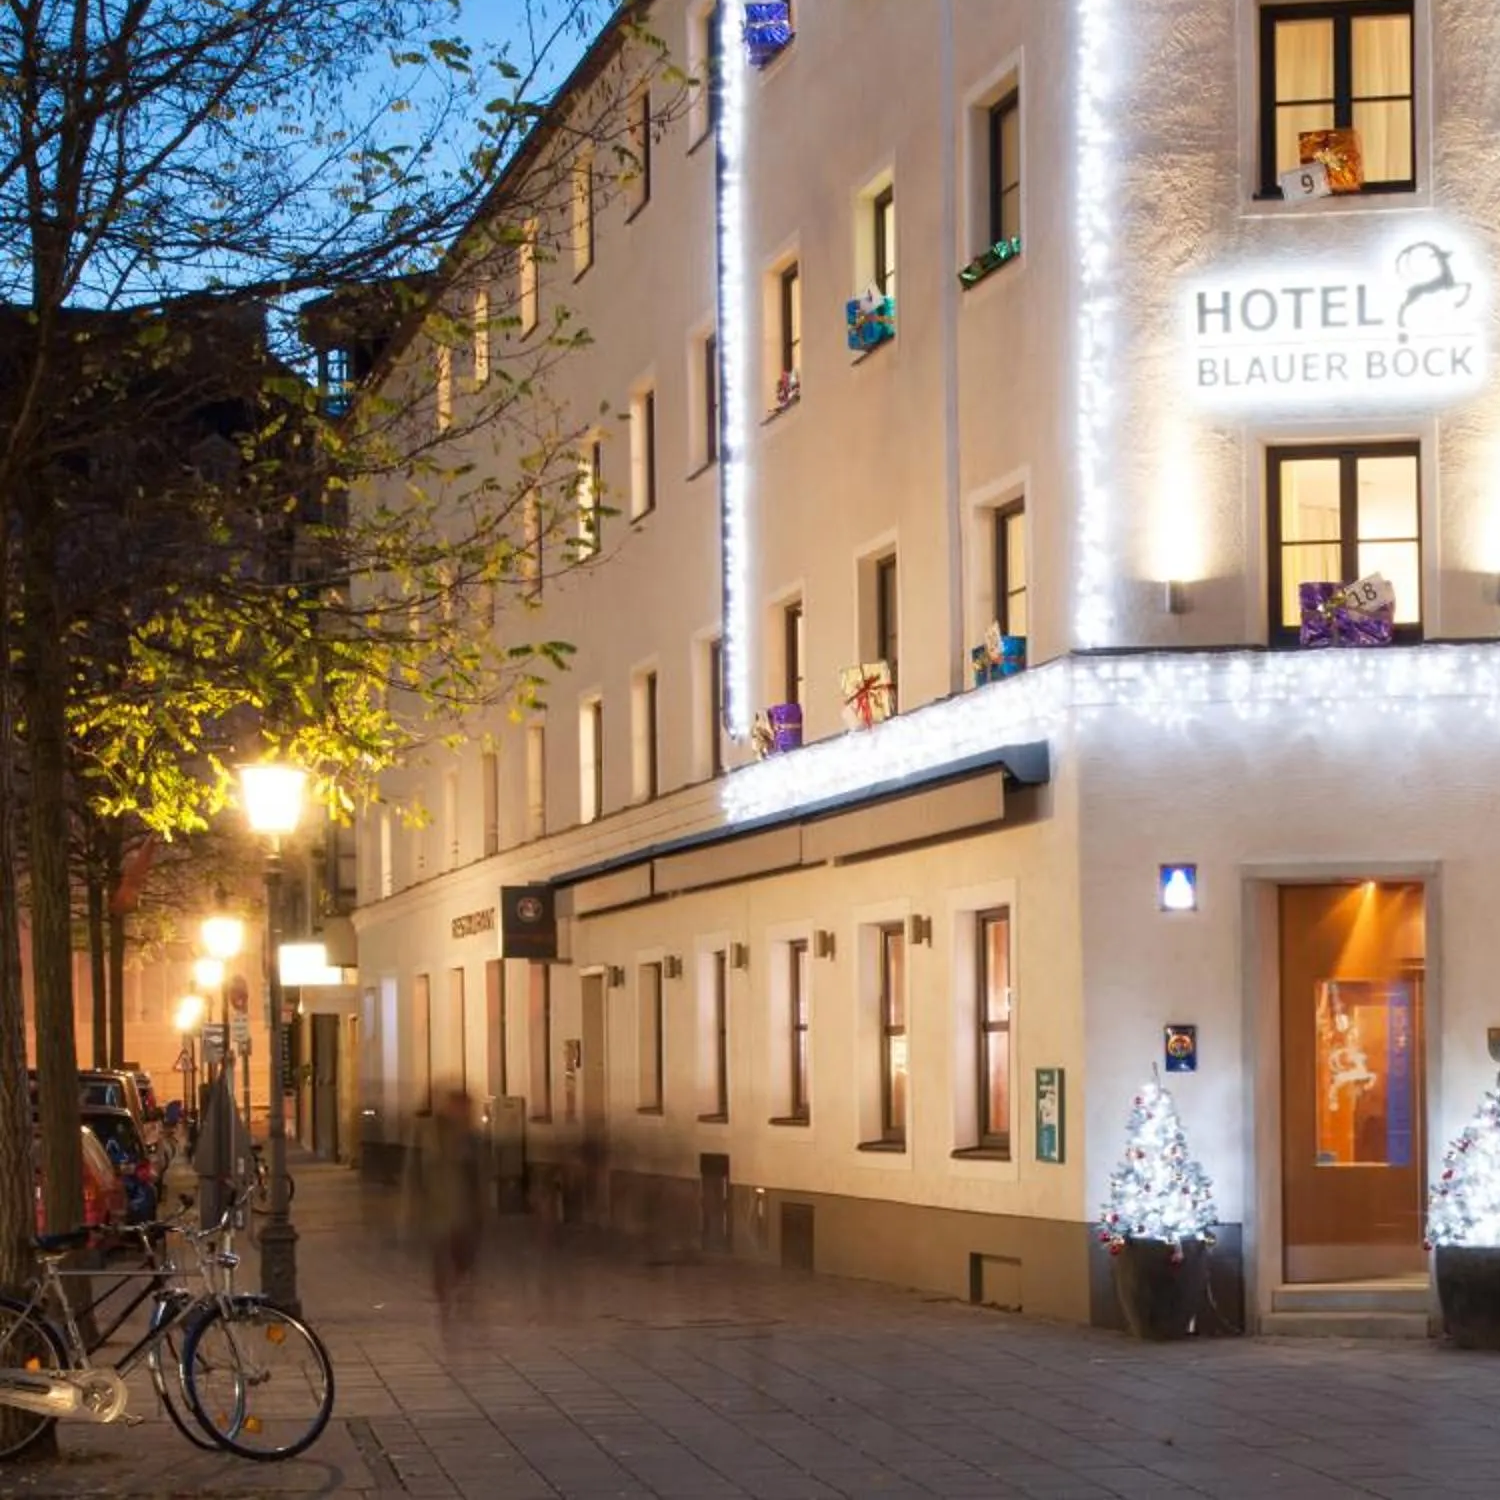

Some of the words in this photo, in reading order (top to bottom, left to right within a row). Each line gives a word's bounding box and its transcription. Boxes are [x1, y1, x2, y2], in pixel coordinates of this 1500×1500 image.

[1197, 284, 1385, 334] HOTEL
[1198, 352, 1349, 387] BLAUER
[1366, 346, 1474, 380] BOCK
[1347, 581, 1378, 607] 18
